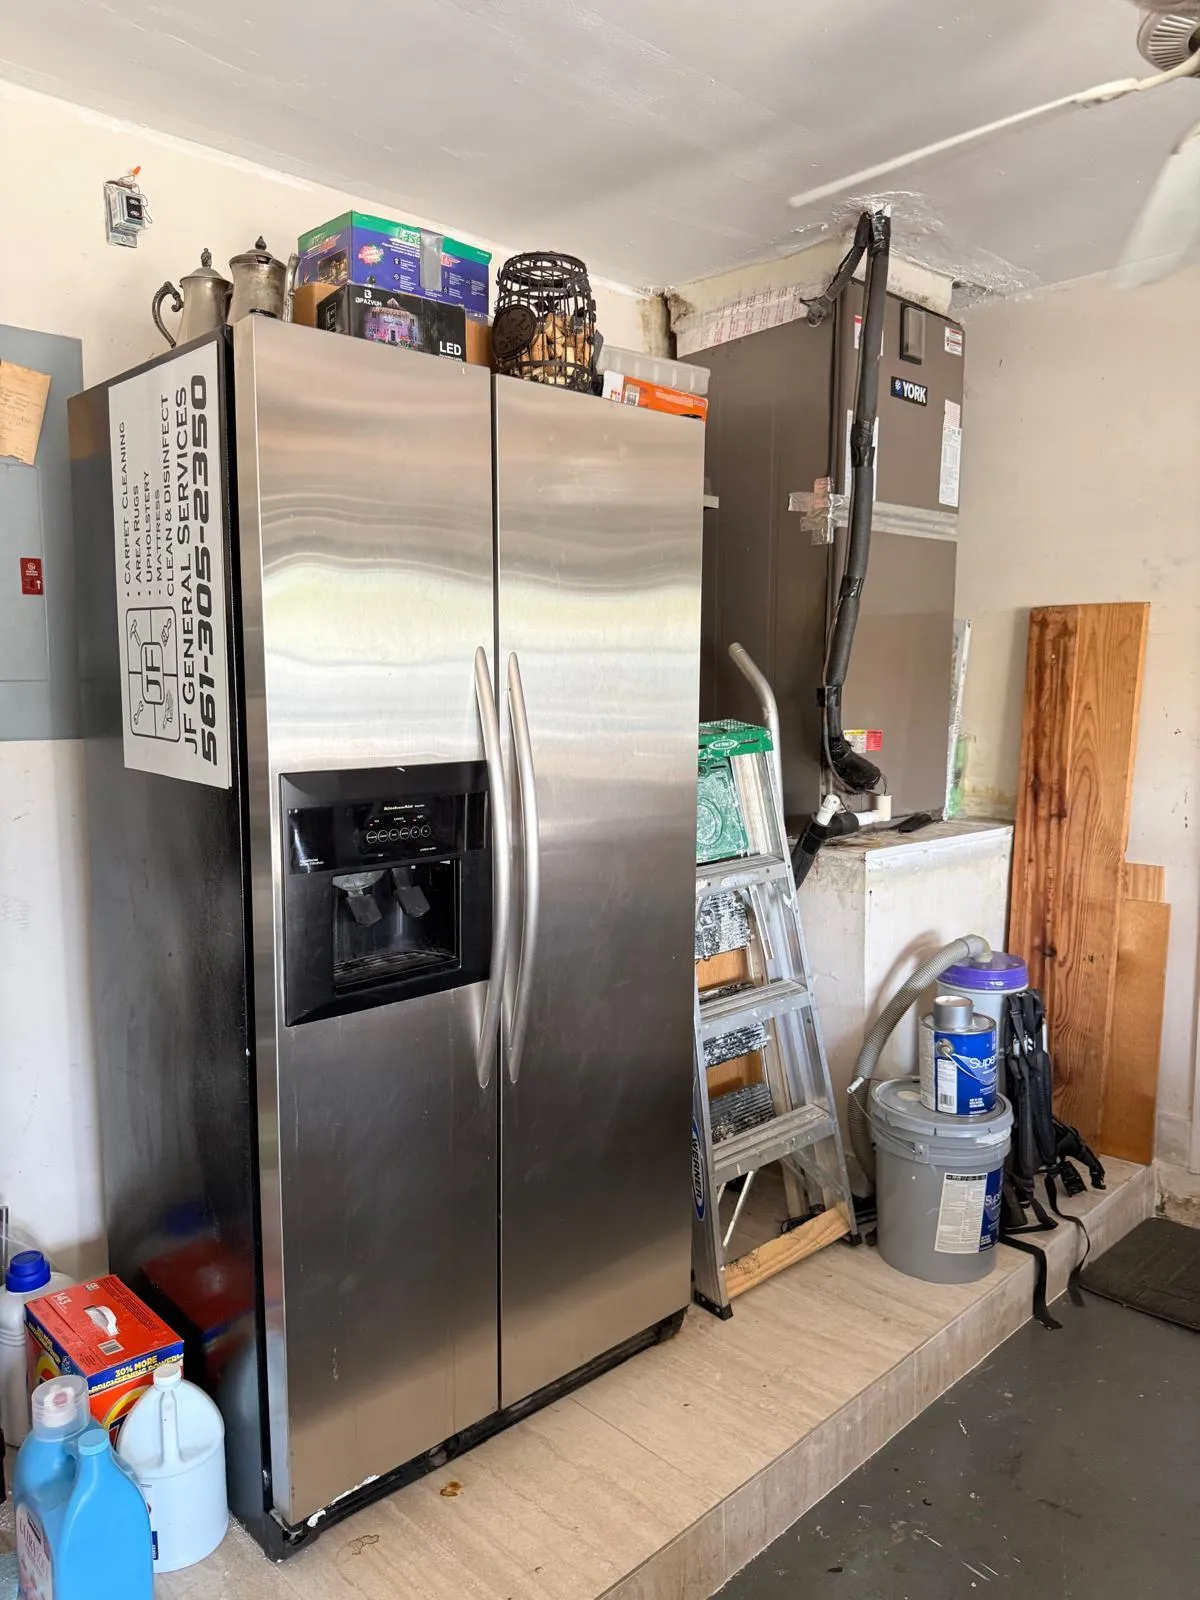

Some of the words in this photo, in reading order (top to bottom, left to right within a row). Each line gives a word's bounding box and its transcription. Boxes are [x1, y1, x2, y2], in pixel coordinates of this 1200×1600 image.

[439, 340, 462, 356] LED
[902, 381, 927, 403] YORK
[118, 421, 129, 508] CLEANING
[160, 394, 171, 503] DISINFECT
[175, 387, 191, 544] SERVICES
[132, 484, 140, 531] RUGS
[143, 471, 153, 582] UPHOLSTERY
[154, 488, 162, 582] MATTRESS
[164, 507, 172, 521] &
[123, 518, 131, 585] CARPET
[164, 527, 175, 596] CLEAN
[190, 374, 218, 766] 561-305-2350
[180, 554, 195, 704] GENERAL
[145, 646, 163, 700] JF
[183, 713, 198, 754] JF
[692, 1138, 703, 1199] WERNER
[115, 1366, 133, 1377] 30%
[135, 1355, 158, 1370] MORE
